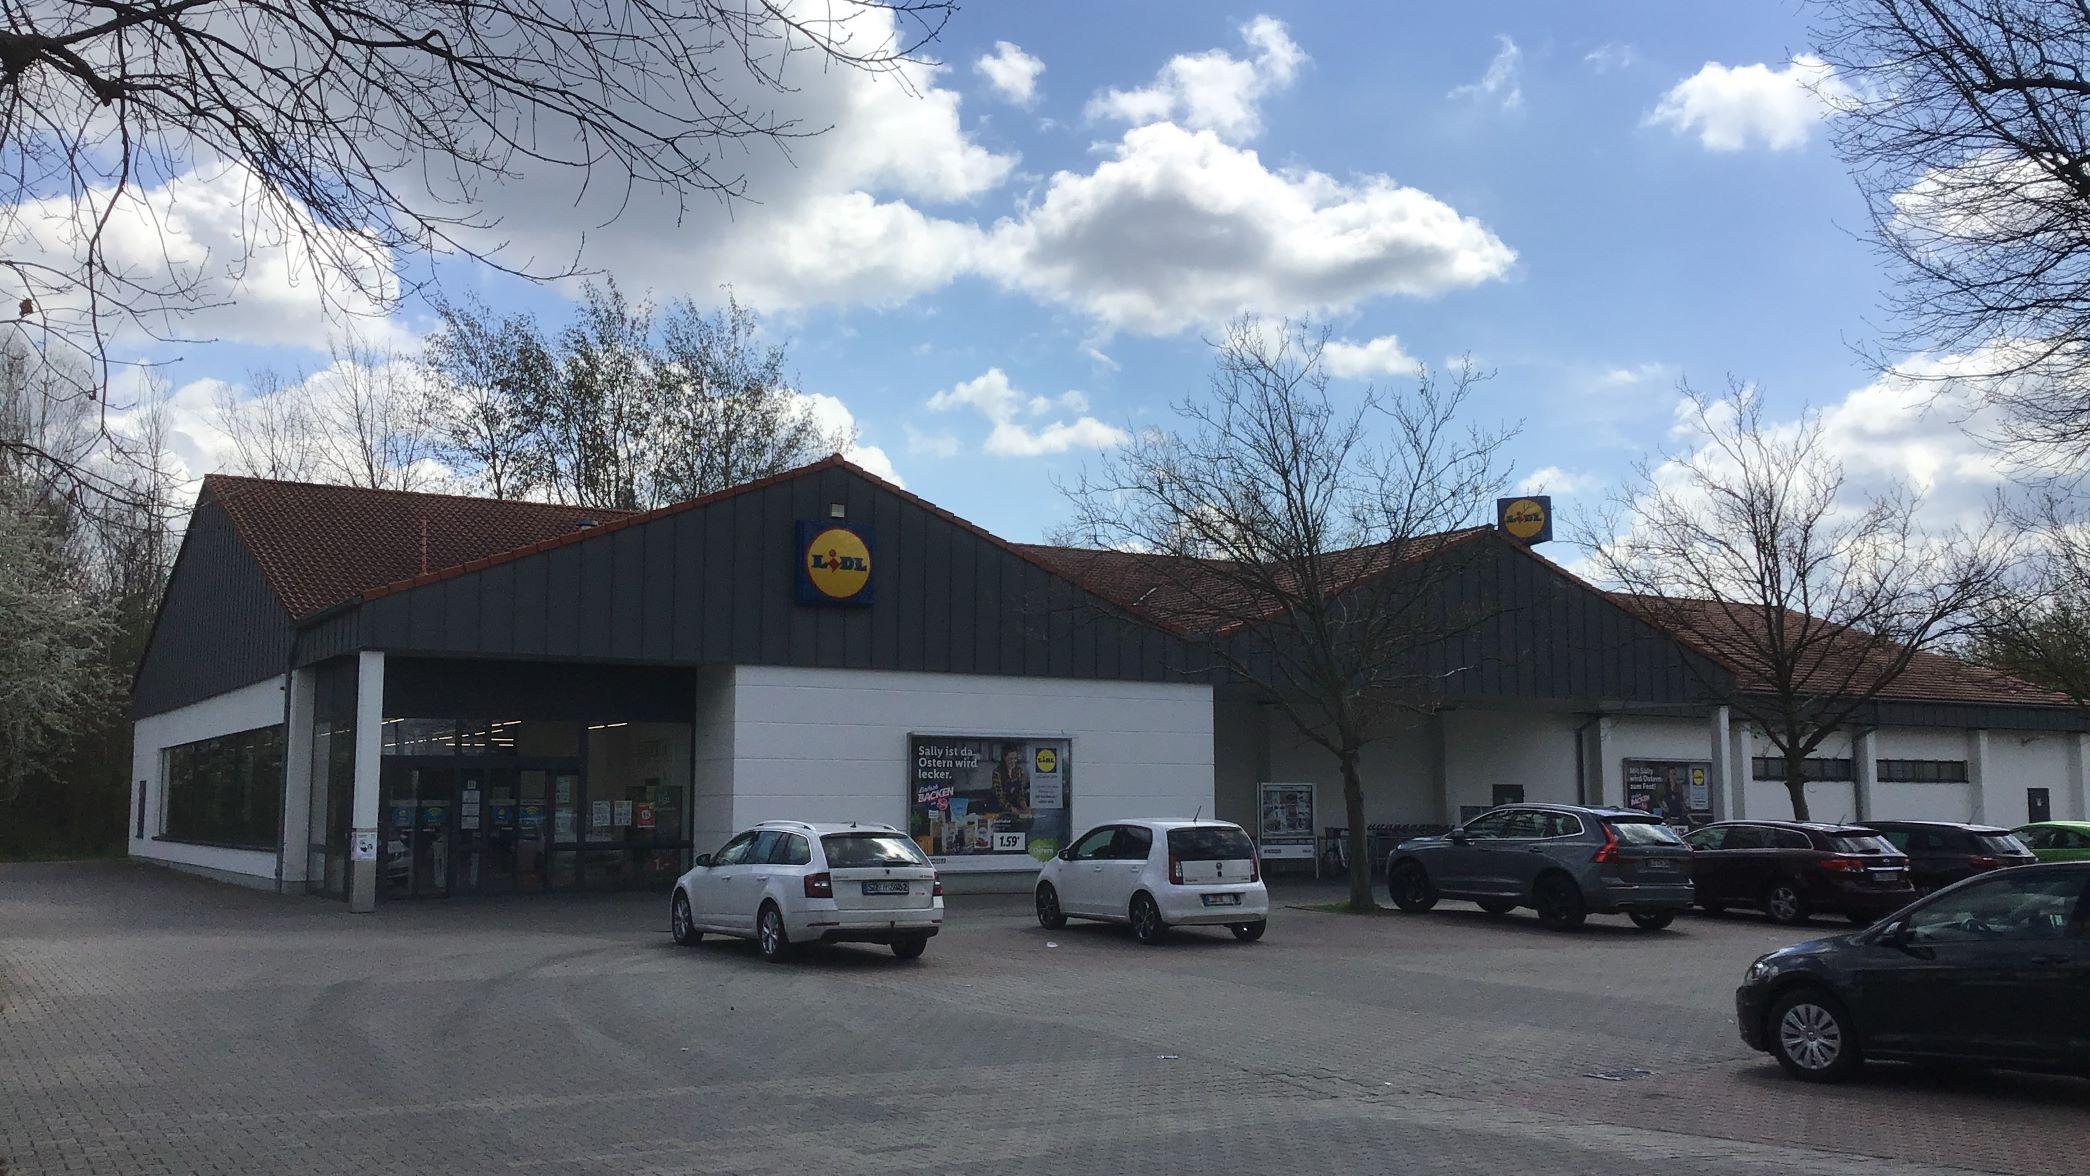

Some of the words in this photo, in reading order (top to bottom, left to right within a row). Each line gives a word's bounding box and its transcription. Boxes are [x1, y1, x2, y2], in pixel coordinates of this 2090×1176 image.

[918, 746, 943, 758] Sally
[945, 746, 958, 756] ist
[918, 757, 953, 768] Ostern
[955, 757, 978, 768] wird
[918, 769, 952, 779] lecker.
[917, 786, 954, 802] BACKEN
